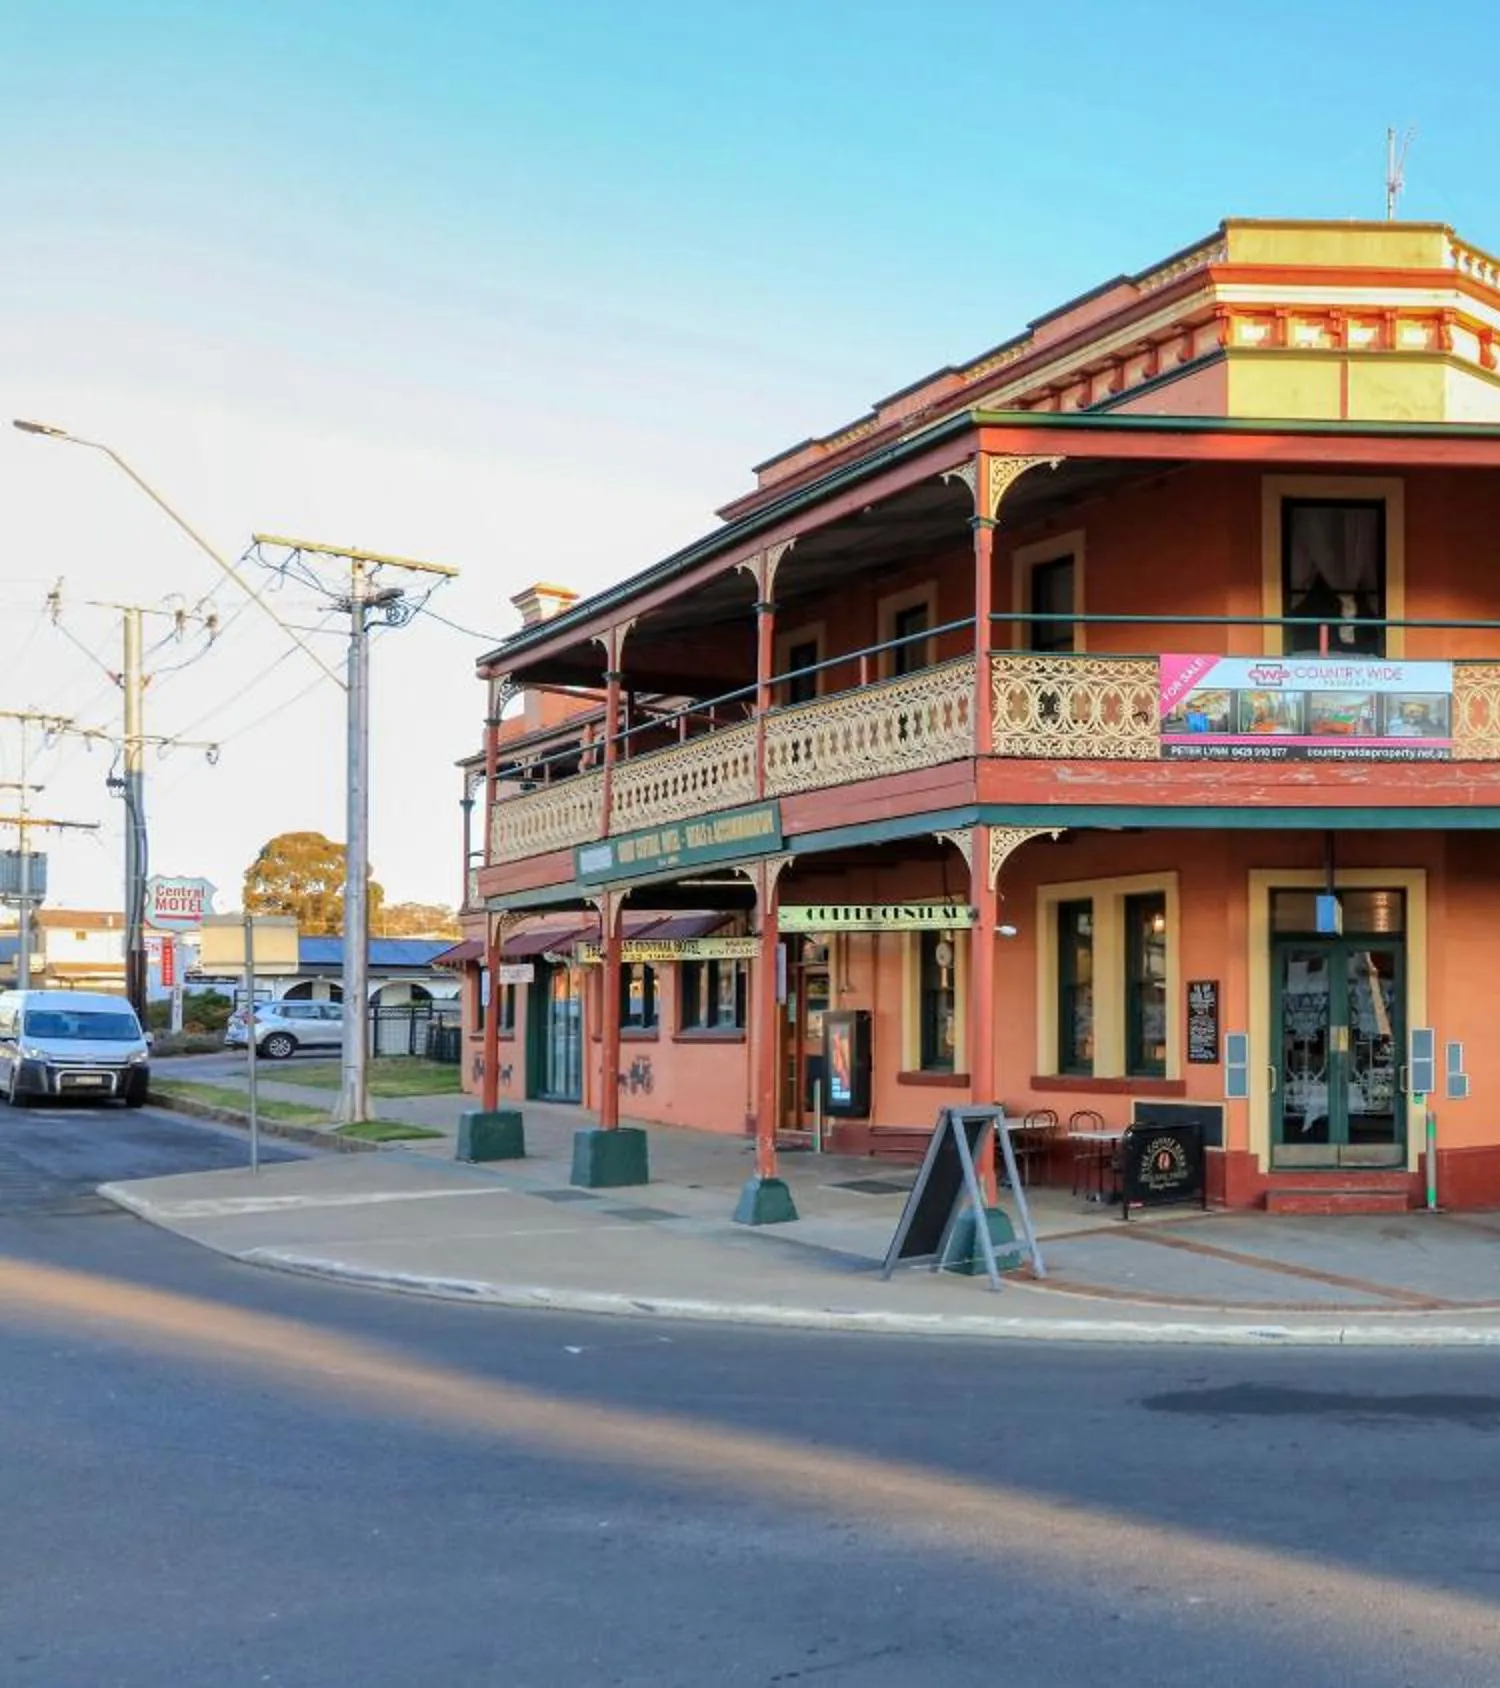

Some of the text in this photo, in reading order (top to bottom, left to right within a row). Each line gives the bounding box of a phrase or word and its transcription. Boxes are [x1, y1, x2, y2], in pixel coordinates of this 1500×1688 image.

[1295, 666, 1404, 681] COUNTRY WIDE
[1171, 745, 1201, 756] PETER
[1203, 745, 1228, 756] LYNN
[155, 884, 205, 912] Central MOTEL
